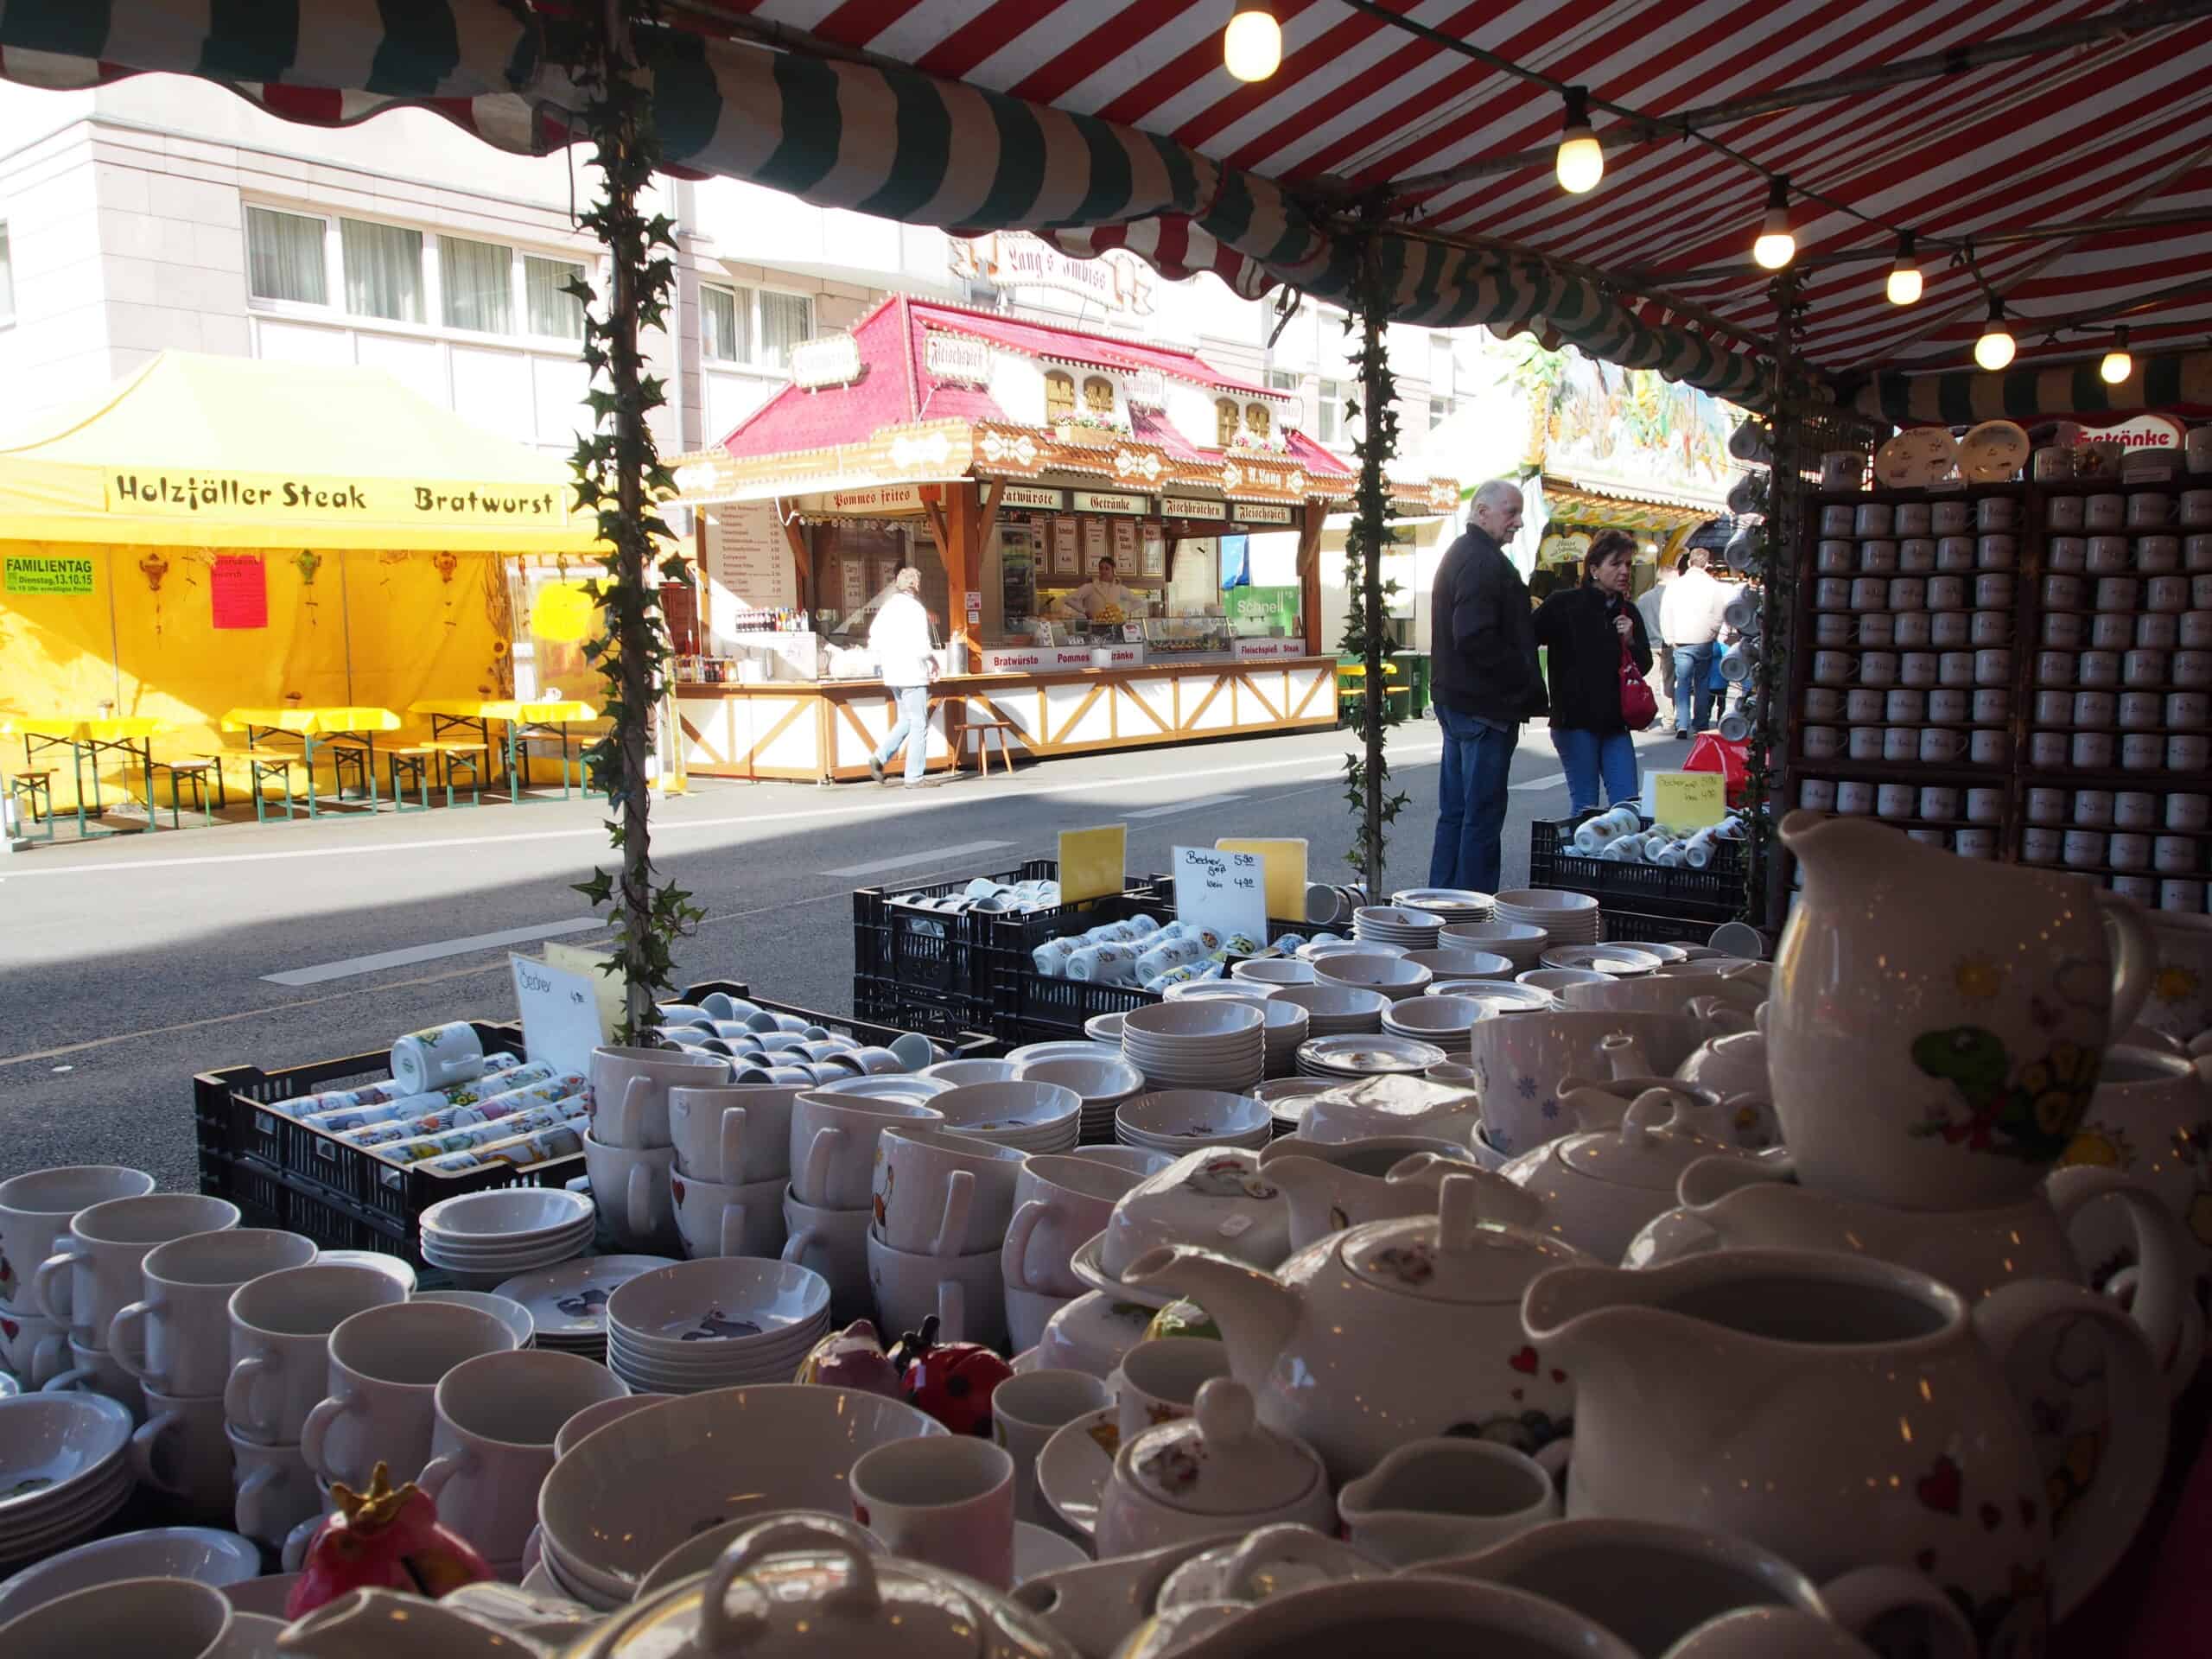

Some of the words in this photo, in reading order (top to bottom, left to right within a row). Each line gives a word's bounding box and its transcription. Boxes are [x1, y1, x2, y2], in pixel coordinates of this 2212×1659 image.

[116, 474, 272, 511] Holzfäller
[283, 482, 366, 509] Steak
[414, 486, 553, 513] Bratwurst
[1001, 489, 1053, 505] ratwürste
[833, 492, 876, 512] Pommes
[1090, 497, 1130, 511] Getränke
[7, 558, 92, 573] FAMILIENTAG
[994, 654, 1039, 667] Bratwürste
[1057, 653, 1090, 664] Pommes
